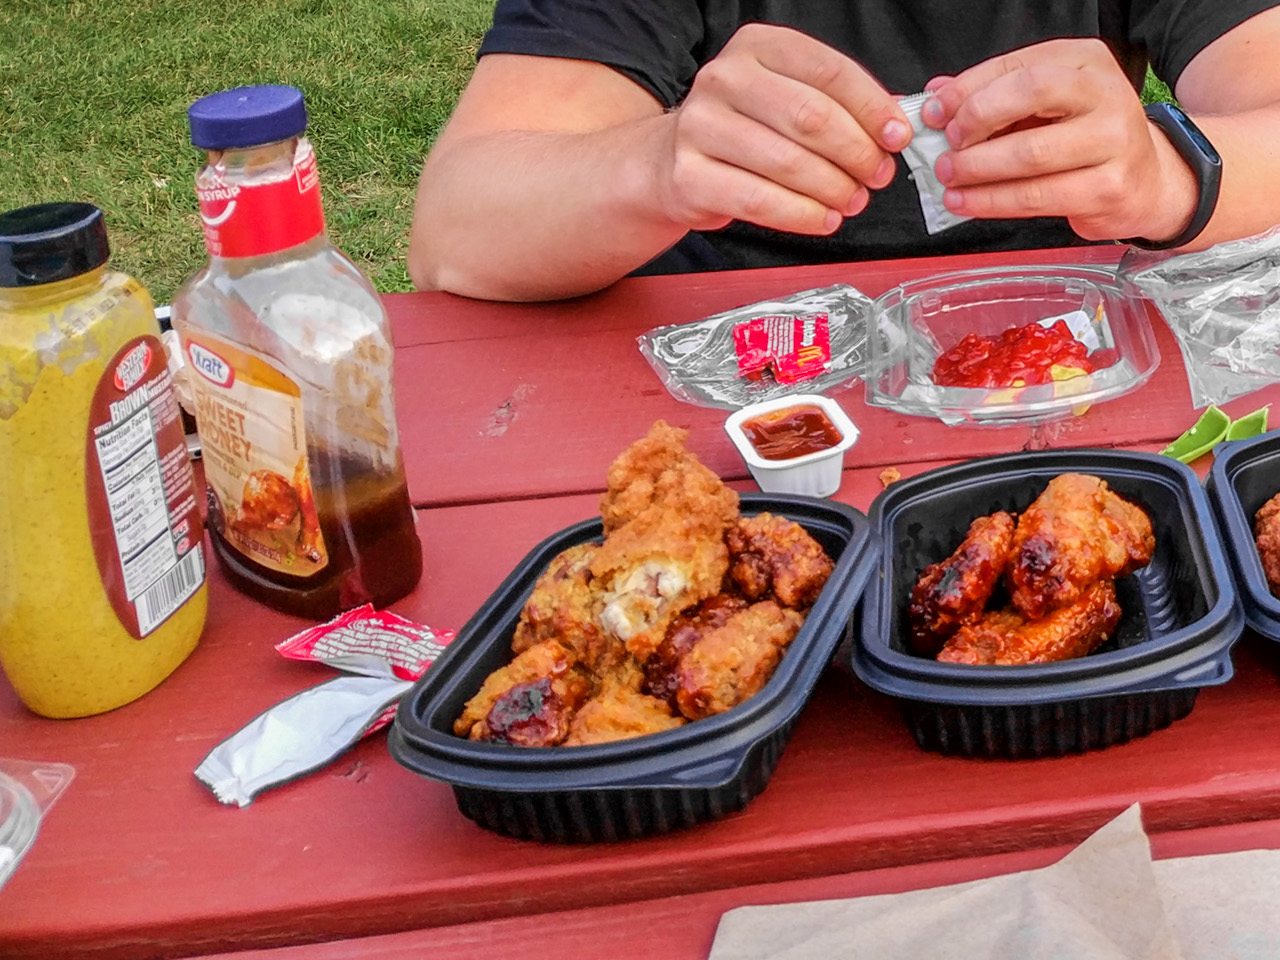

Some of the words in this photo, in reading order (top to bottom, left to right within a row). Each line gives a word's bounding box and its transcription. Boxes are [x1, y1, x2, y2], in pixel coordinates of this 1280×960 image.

[204, 185, 241, 201] SYRUP
[109, 385, 149, 425] BROWN
[196, 389, 245, 436] SWEET
[99, 426, 131, 450] Nutrition
[132, 413, 148, 431] Facts
[199, 420, 251, 462] HONEY
[112, 499, 127, 511] Total
[117, 521, 132, 534] Total
